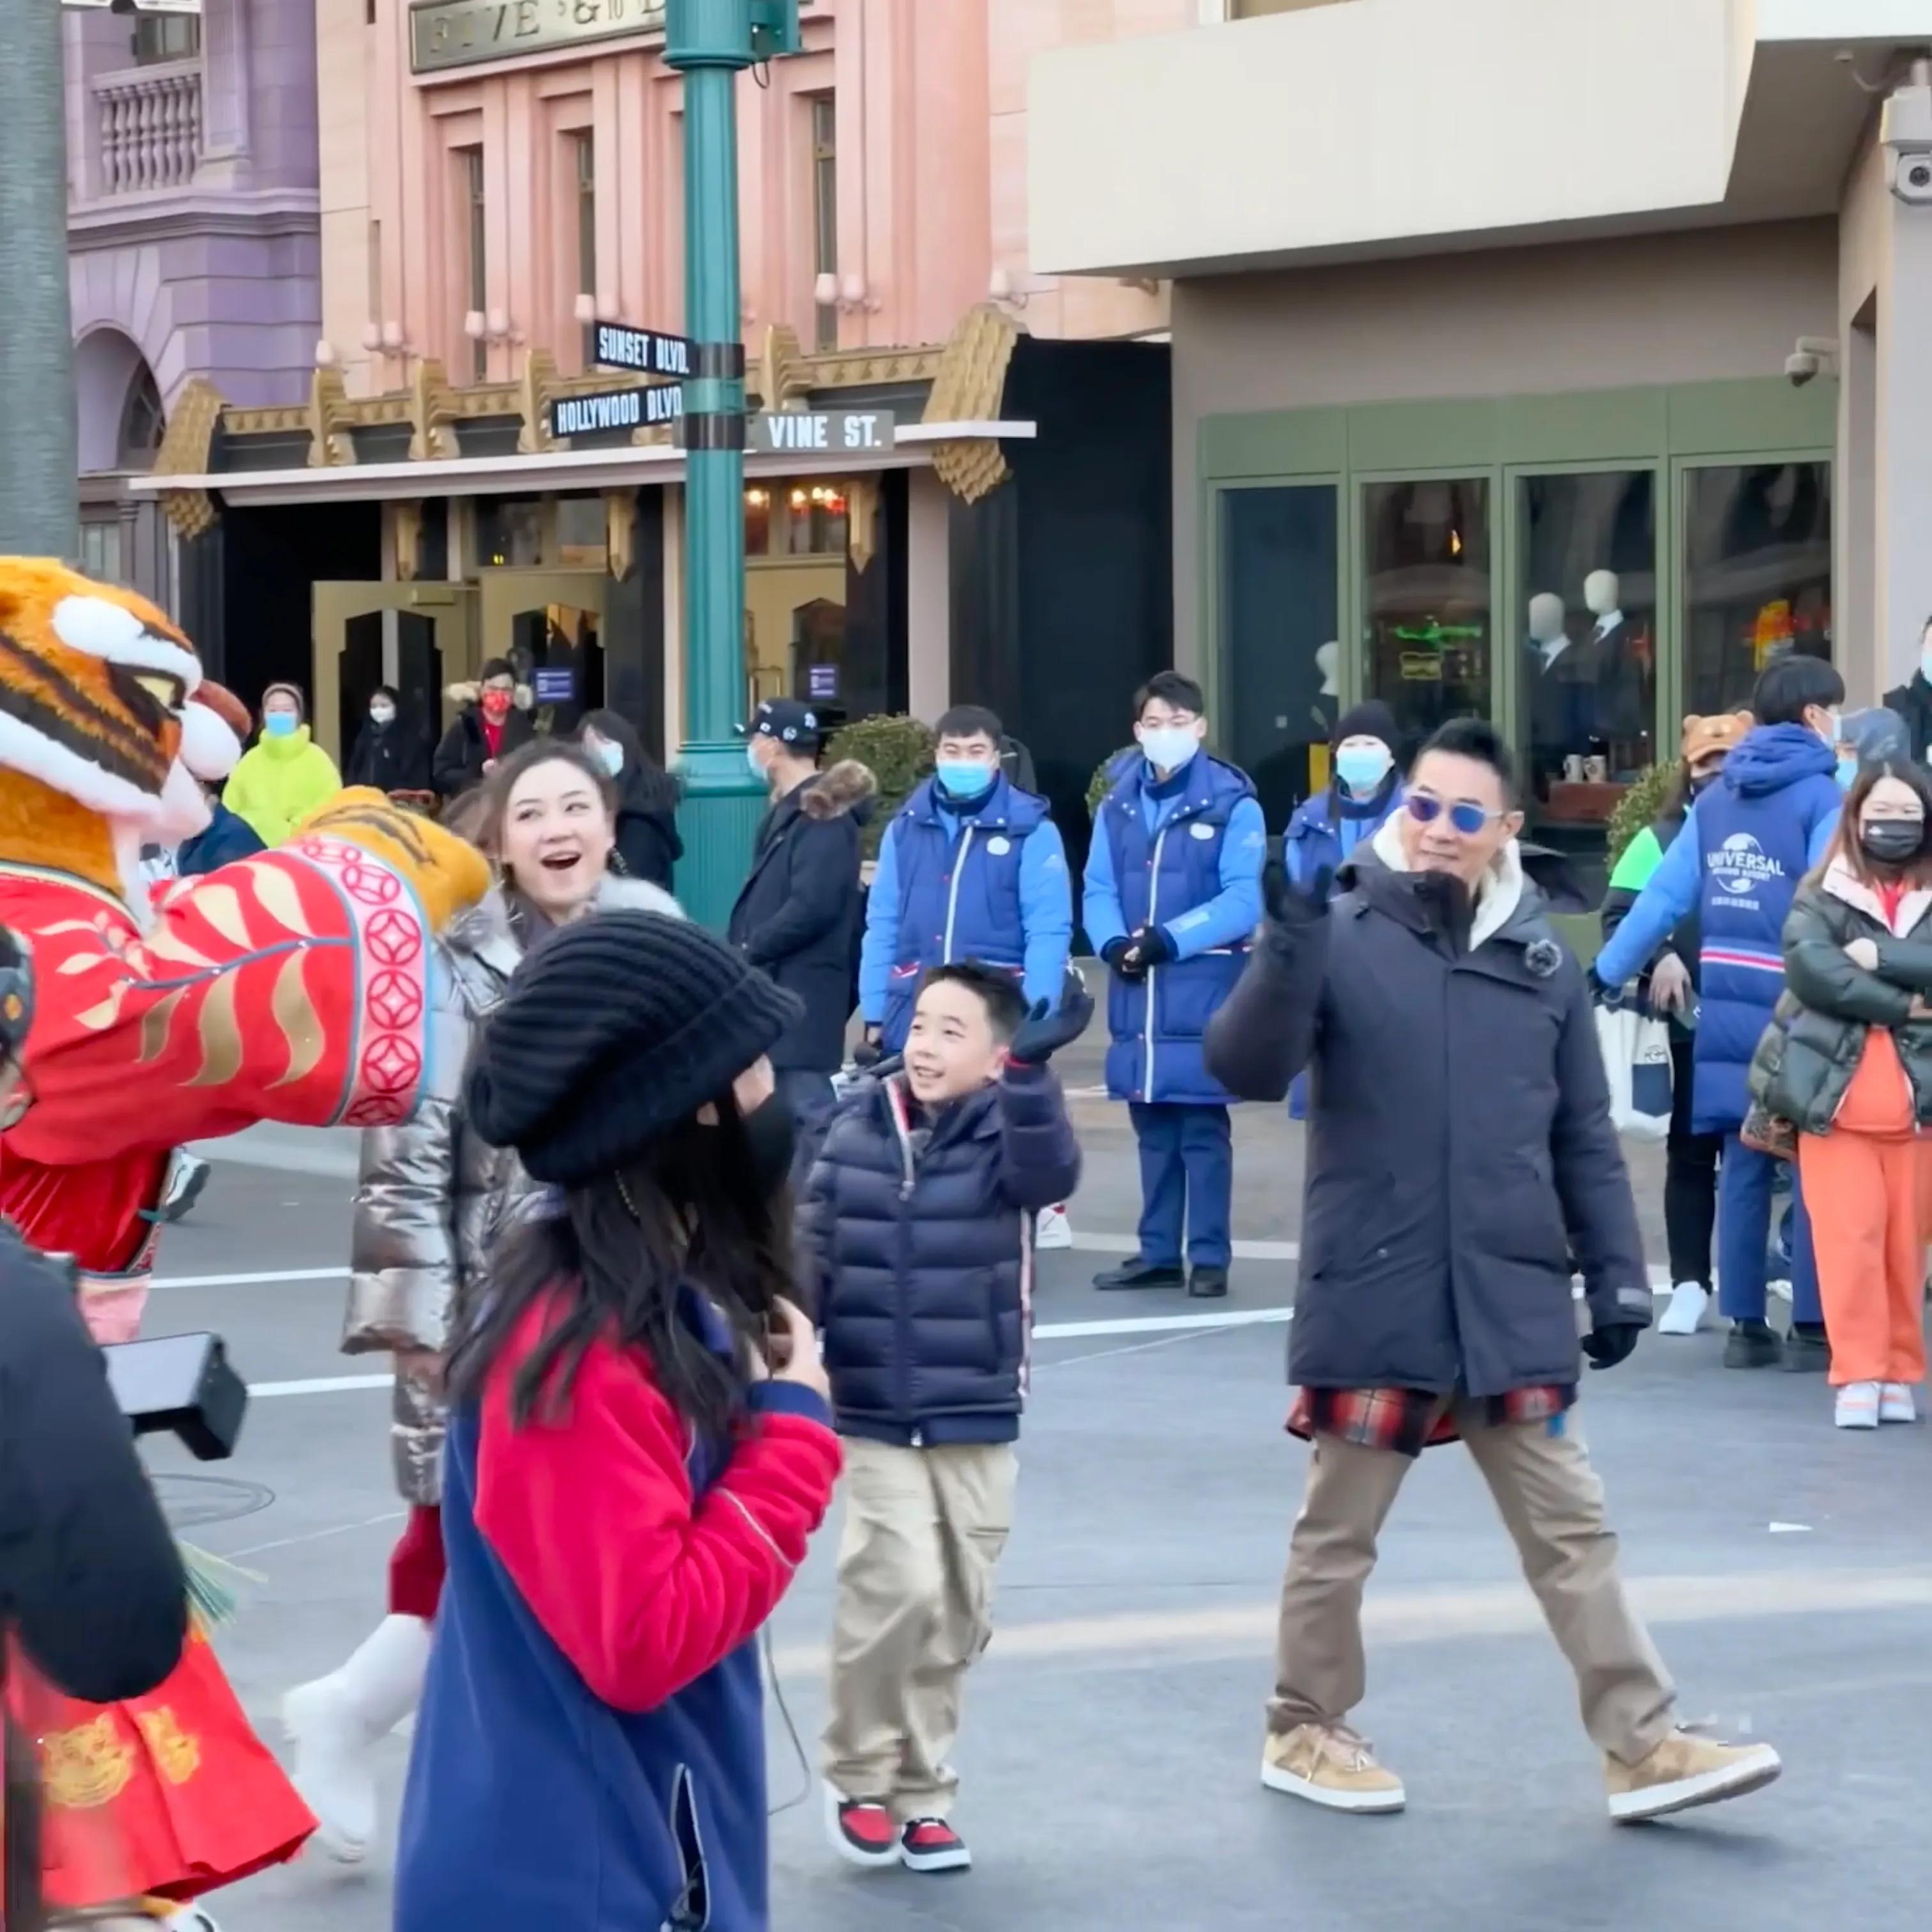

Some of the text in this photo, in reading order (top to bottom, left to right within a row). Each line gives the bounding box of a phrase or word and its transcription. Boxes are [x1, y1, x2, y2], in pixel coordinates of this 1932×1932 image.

[599, 326, 690, 374] SUNSET BLVD.
[557, 392, 640, 434] HOLLYWOOD
[768, 415, 882, 448] VINE ST.
